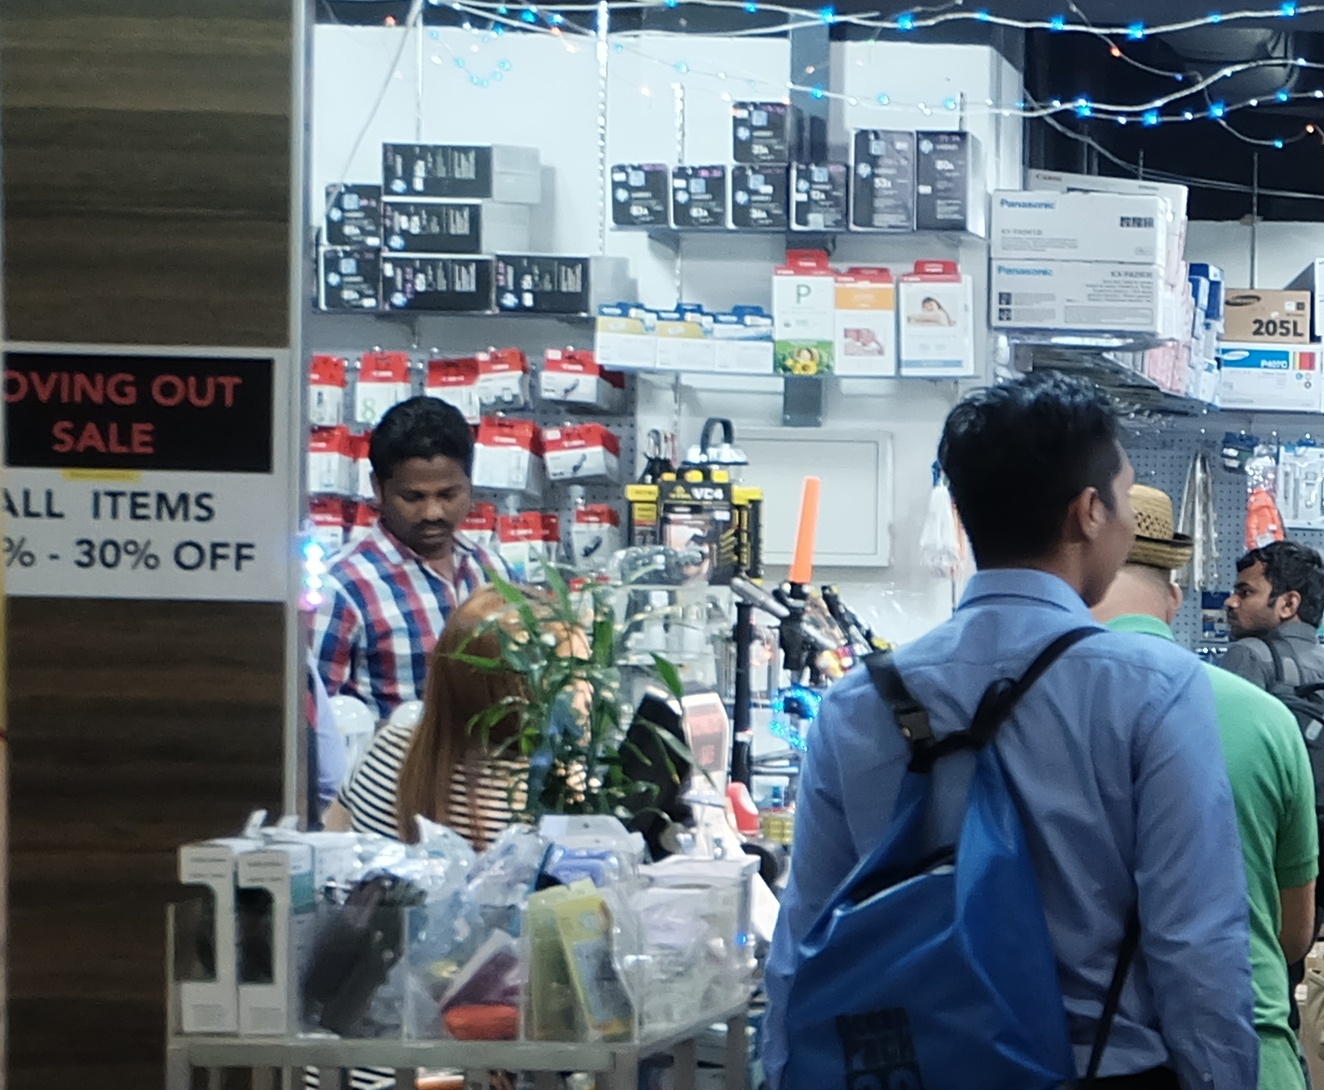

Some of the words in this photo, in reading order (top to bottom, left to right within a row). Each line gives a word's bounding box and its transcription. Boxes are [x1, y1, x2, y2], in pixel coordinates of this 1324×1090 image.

[1000, 199, 1056, 210] Panasonic
[998, 265, 1054, 277] Panasonic
[1252, 318, 1305, 338] 205L
[5, 370, 138, 406] OVING
[152, 374, 243, 408] OUT
[52, 420, 156, 455] SALE
[92, 489, 216, 523] ITEMS
[74, 538, 161, 570] 30%
[174, 540, 256, 571] OFF
